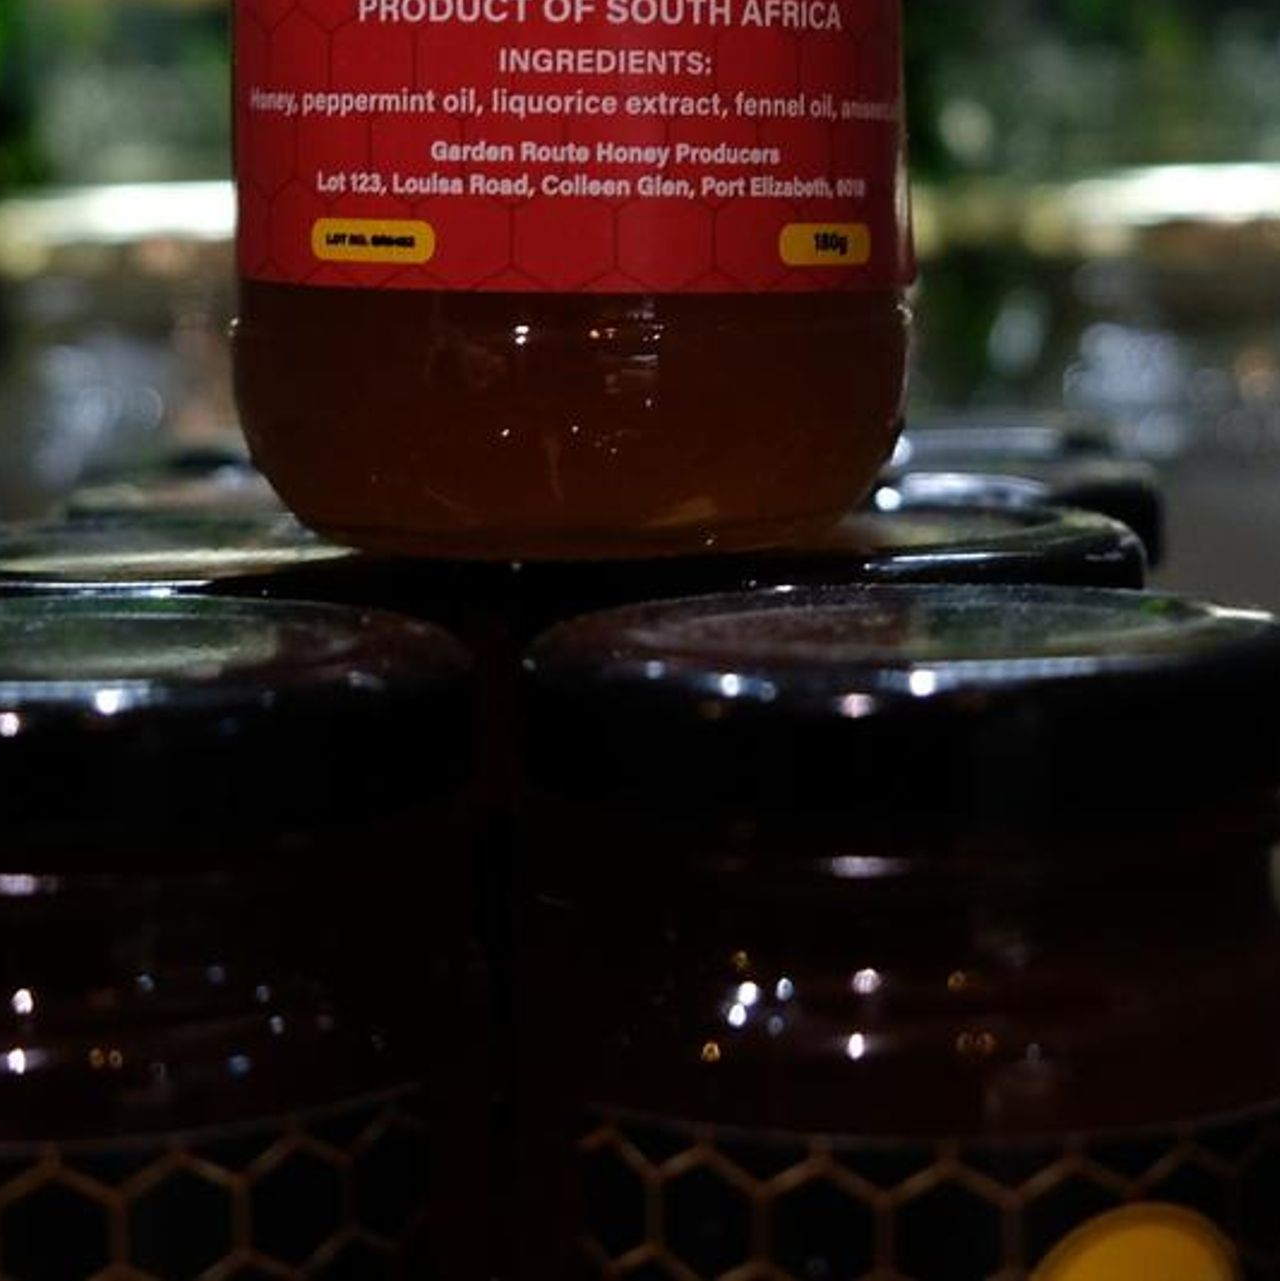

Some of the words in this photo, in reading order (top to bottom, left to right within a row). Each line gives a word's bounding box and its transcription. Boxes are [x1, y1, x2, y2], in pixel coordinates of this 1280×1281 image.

[499, 48, 712, 76] INGREDIENTS:
[301, 87, 436, 117] peppermint
[442, 88, 484, 117] oil,
[492, 87, 617, 120] liquorice
[625, 92, 728, 119] extract,
[735, 91, 805, 118] fennel
[810, 93, 838, 123] oil,
[430, 140, 514, 162] Garden
[520, 141, 590, 163] Route
[596, 141, 670, 168] Honey
[675, 142, 781, 166] Producers
[317, 170, 346, 193] Lot
[351, 172, 387, 197] 123,
[392, 172, 464, 195] Louisa
[470, 173, 534, 199] Road,
[540, 173, 631, 197] Colleen
[637, 176, 695, 199] Glen,
[701, 176, 745, 198] Port
[750, 177, 834, 200] Elizabeth,
